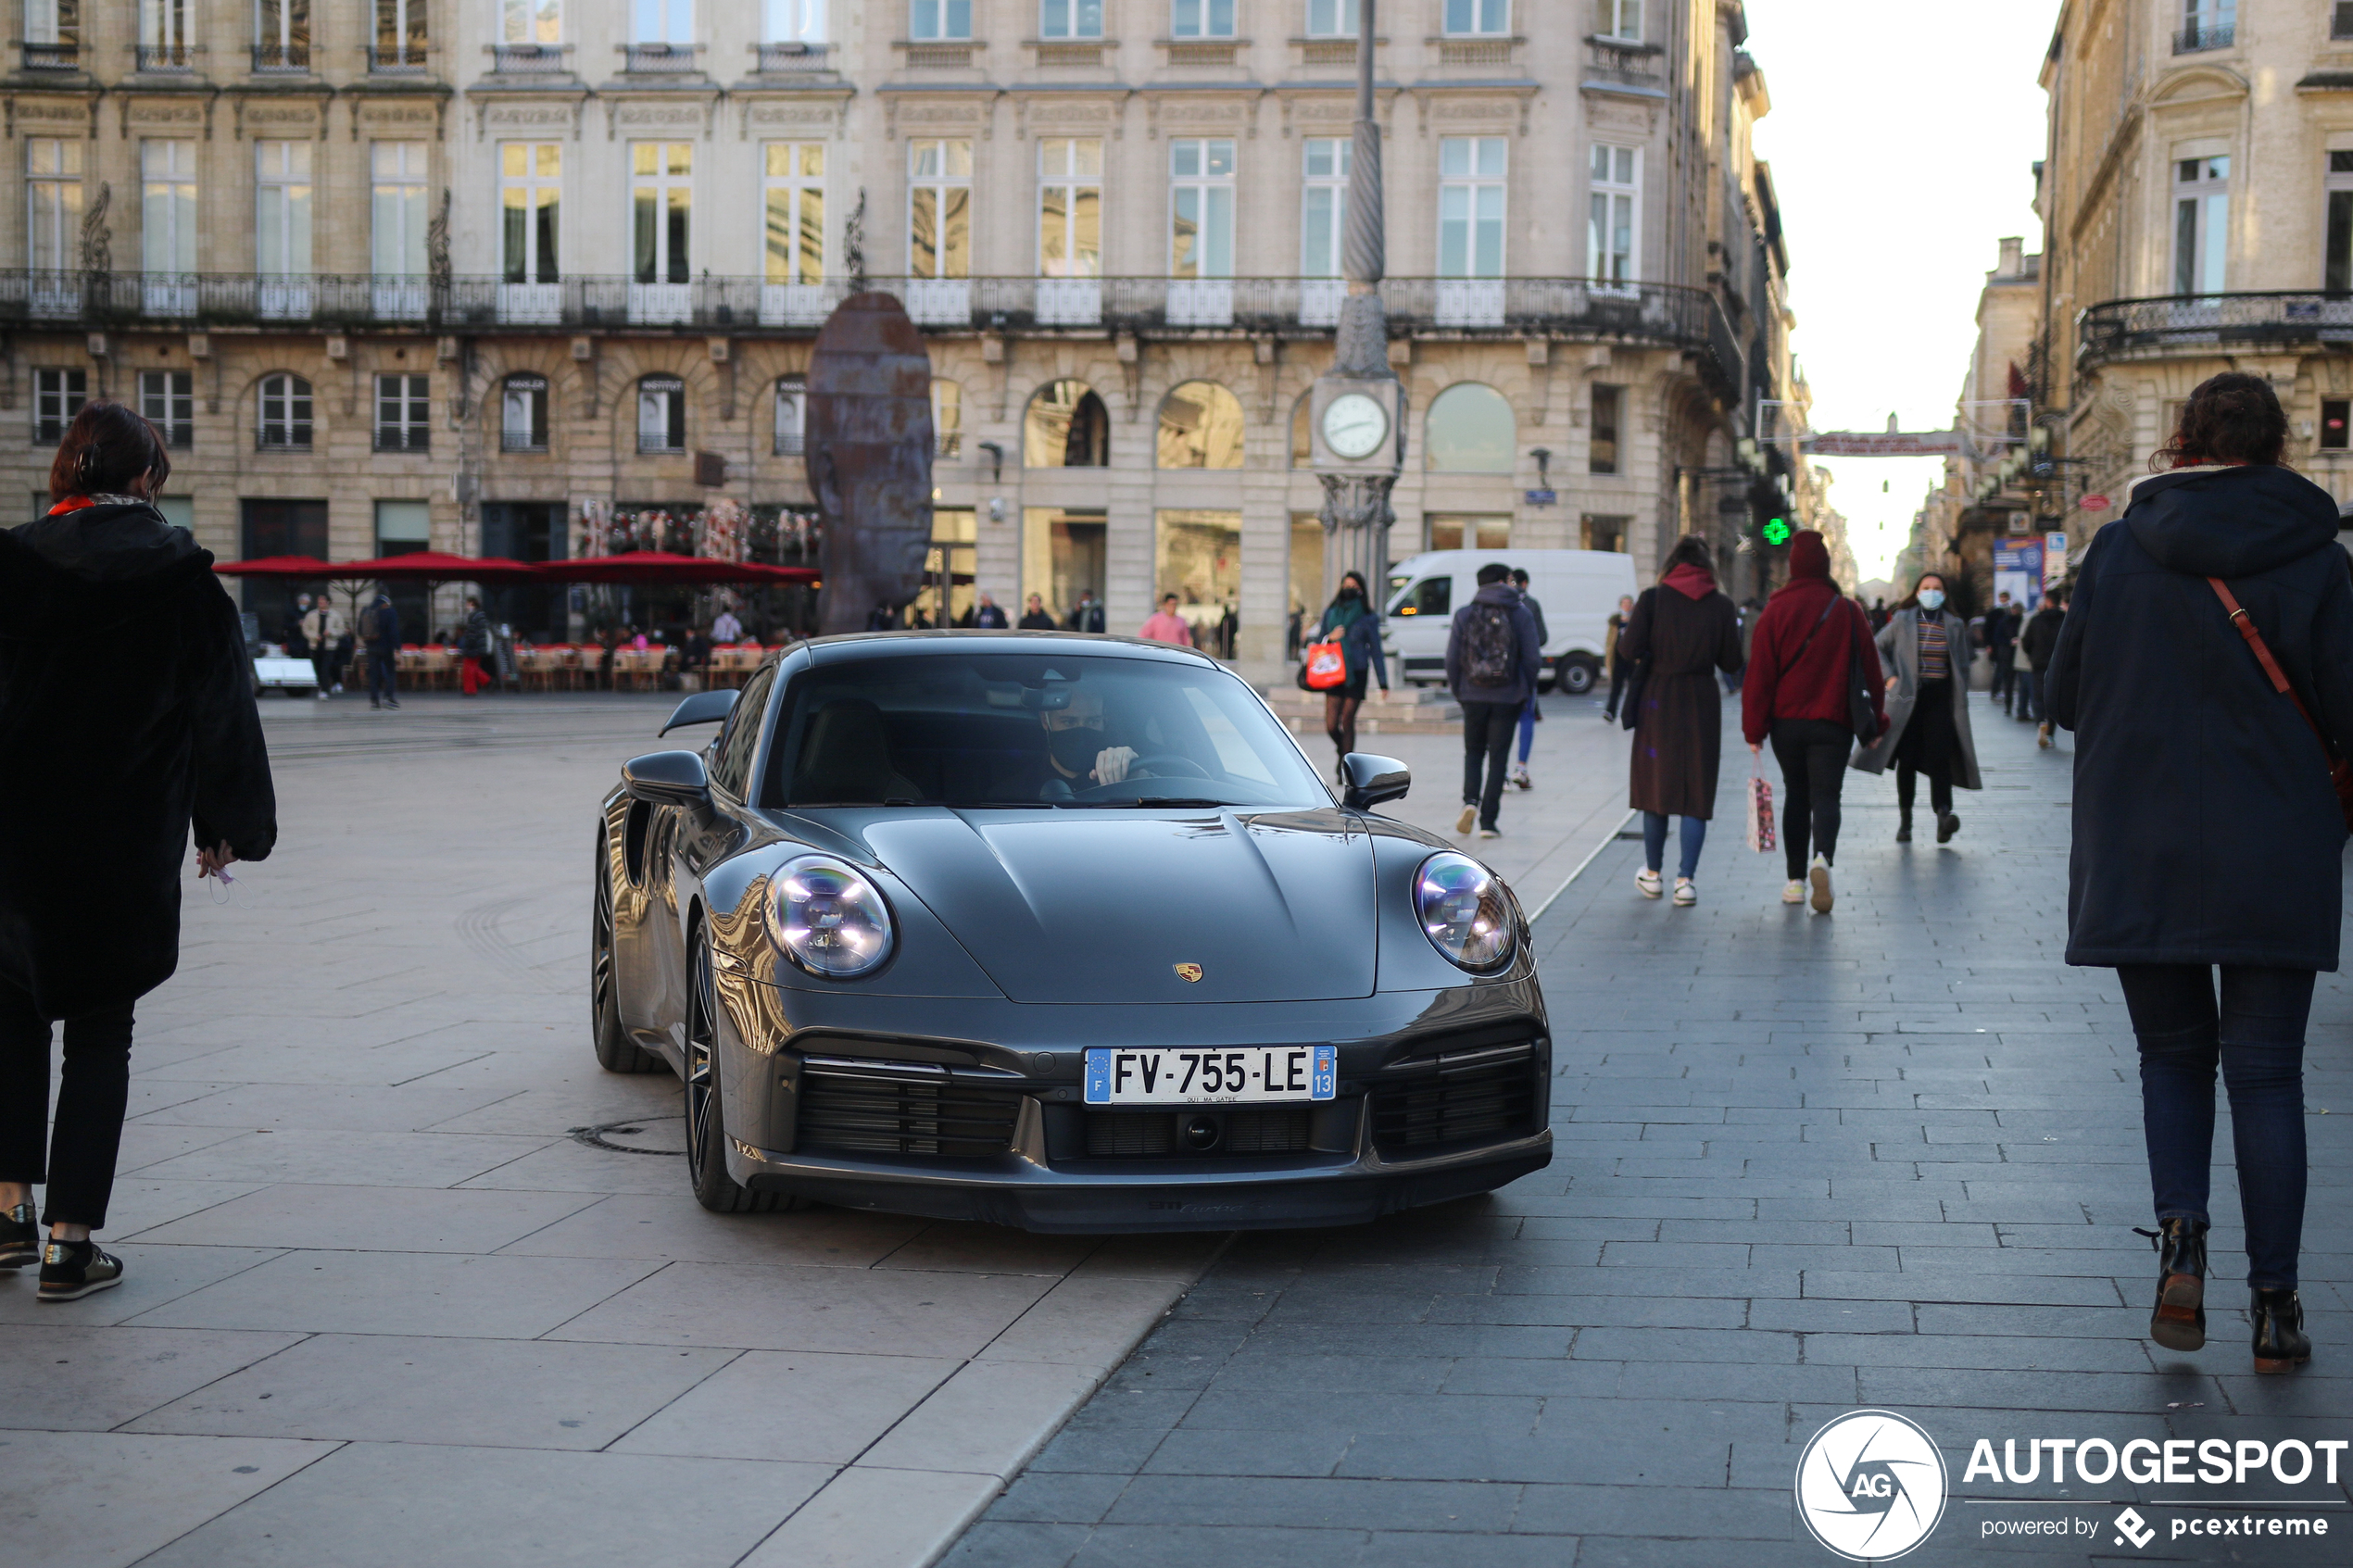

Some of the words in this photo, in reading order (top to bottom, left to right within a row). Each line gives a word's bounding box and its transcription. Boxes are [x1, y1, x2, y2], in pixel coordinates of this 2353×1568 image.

[642, 380, 681, 391] INSTITUT
[1114, 1052, 1307, 1094] FV-755-LE
[1095, 1080, 1102, 1091] F
[1315, 1074, 1332, 1093] 13
